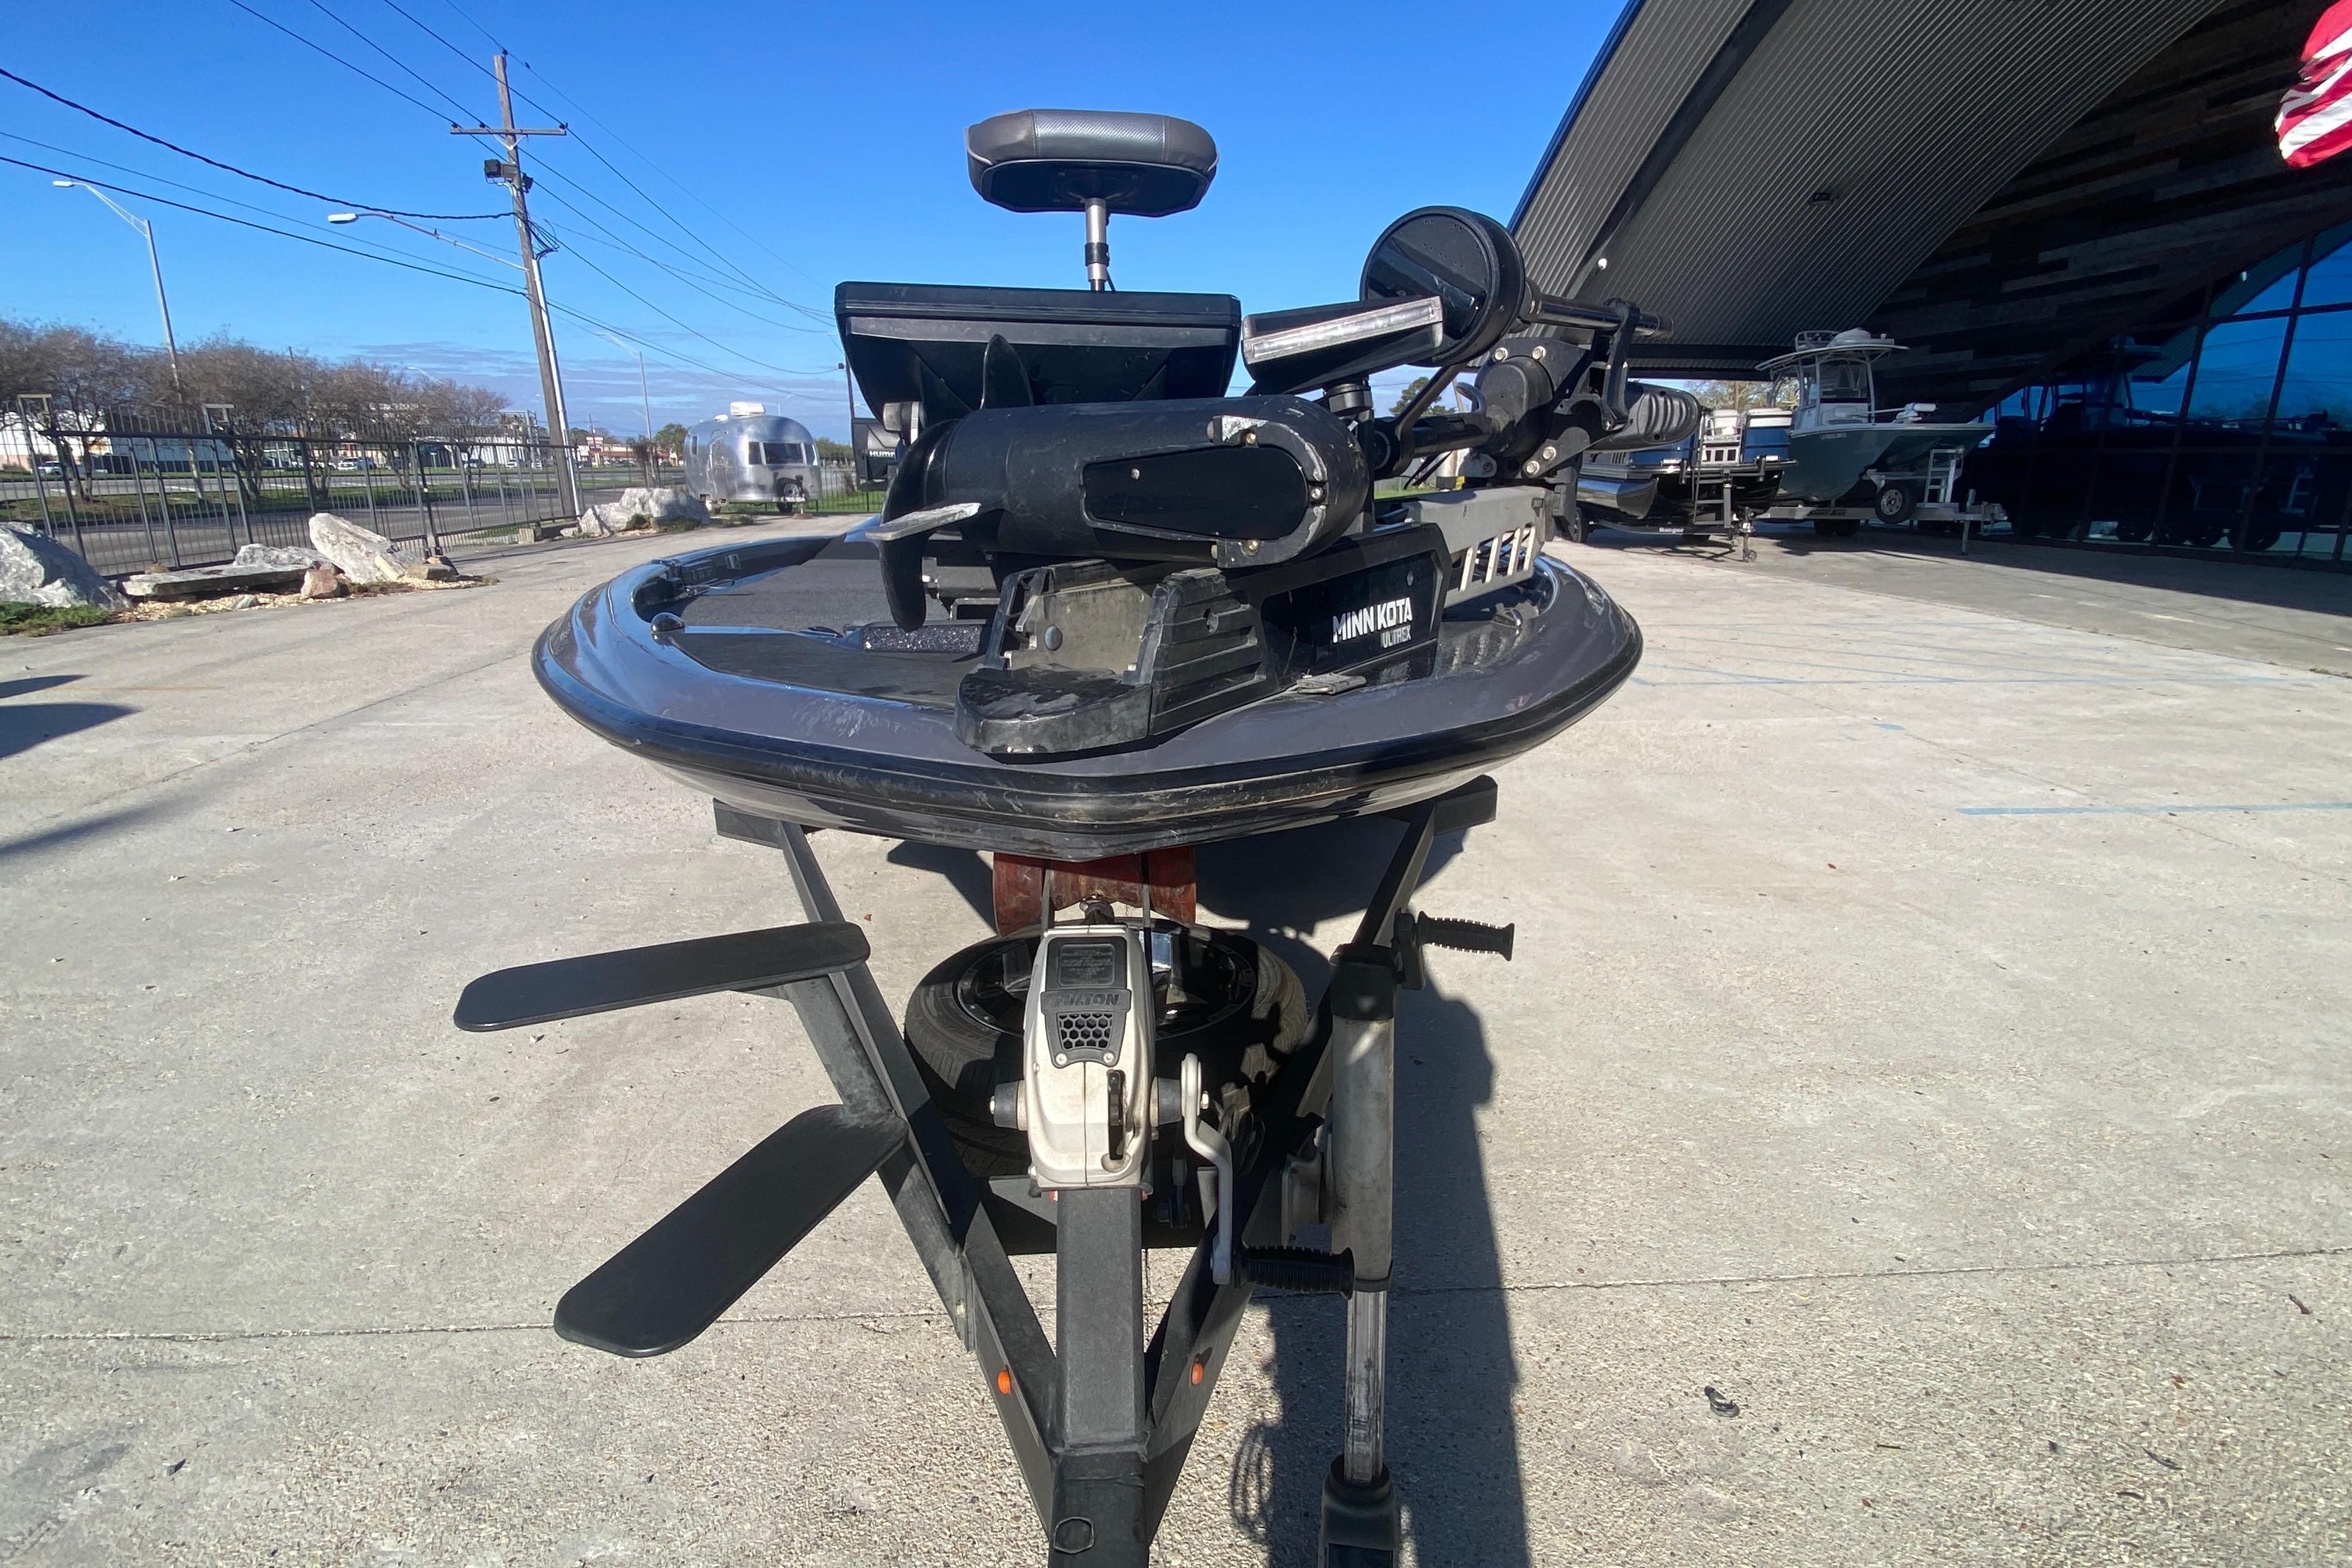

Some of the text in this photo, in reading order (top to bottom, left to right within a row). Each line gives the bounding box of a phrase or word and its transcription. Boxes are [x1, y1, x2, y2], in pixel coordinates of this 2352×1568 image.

[1332, 597, 1413, 643] MINN KOTA
[1381, 625, 1411, 648] ULTREX
[1054, 993, 1119, 1007] FULTON
